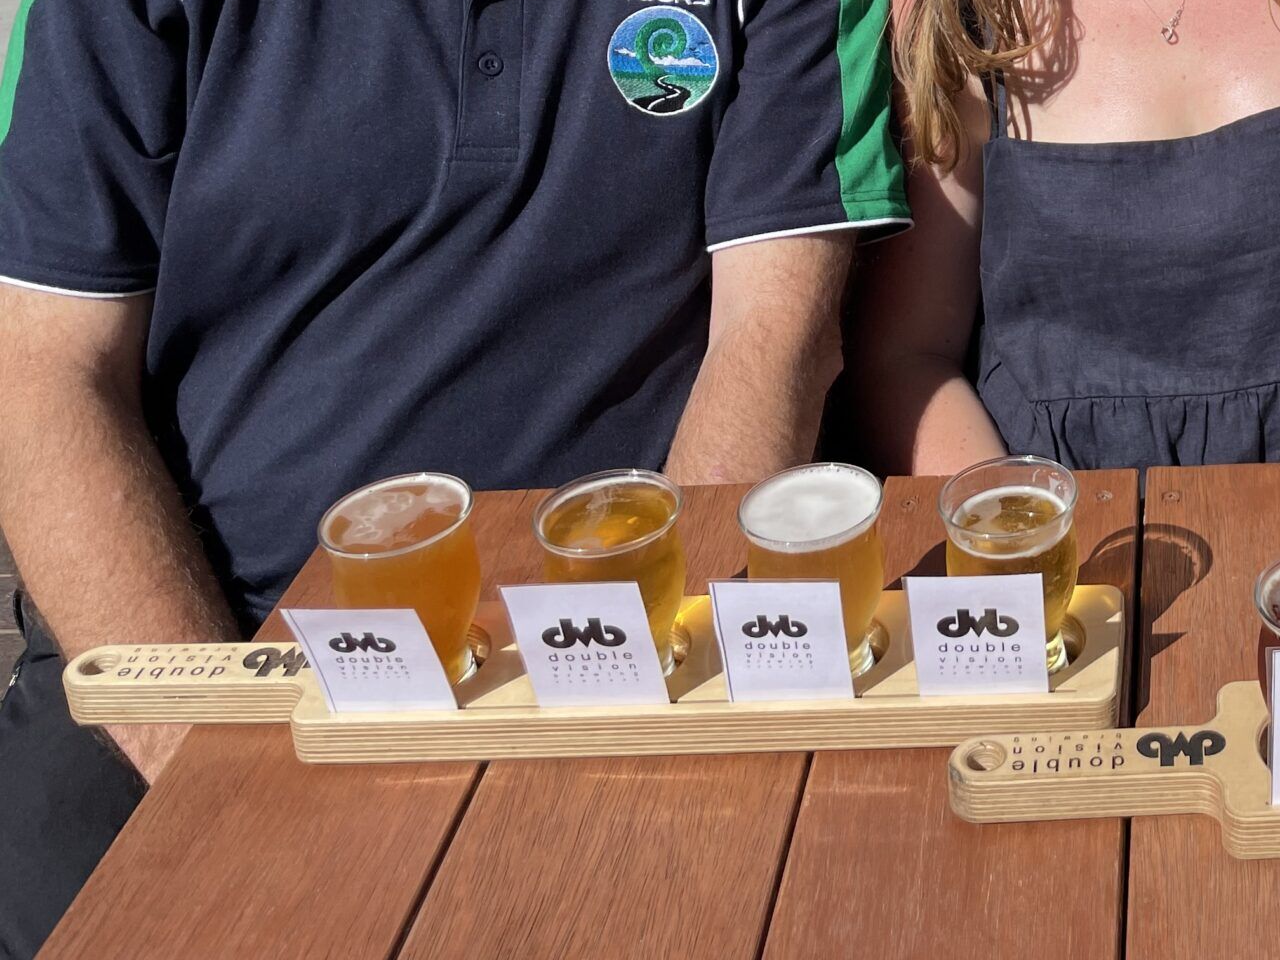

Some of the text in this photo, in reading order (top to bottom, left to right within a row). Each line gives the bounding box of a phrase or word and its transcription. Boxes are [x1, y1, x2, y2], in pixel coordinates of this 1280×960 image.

[744, 641, 811, 650] double
[938, 641, 1021, 653] double
[127, 654, 231, 663] vision
[336, 656, 403, 664] double
[548, 650, 633, 662] double
[939, 655, 1022, 663] vision
[552, 663, 637, 671] vision
[117, 666, 227, 679] double
[1013, 742, 1122, 755] vision
[1012, 755, 1125, 773] double
